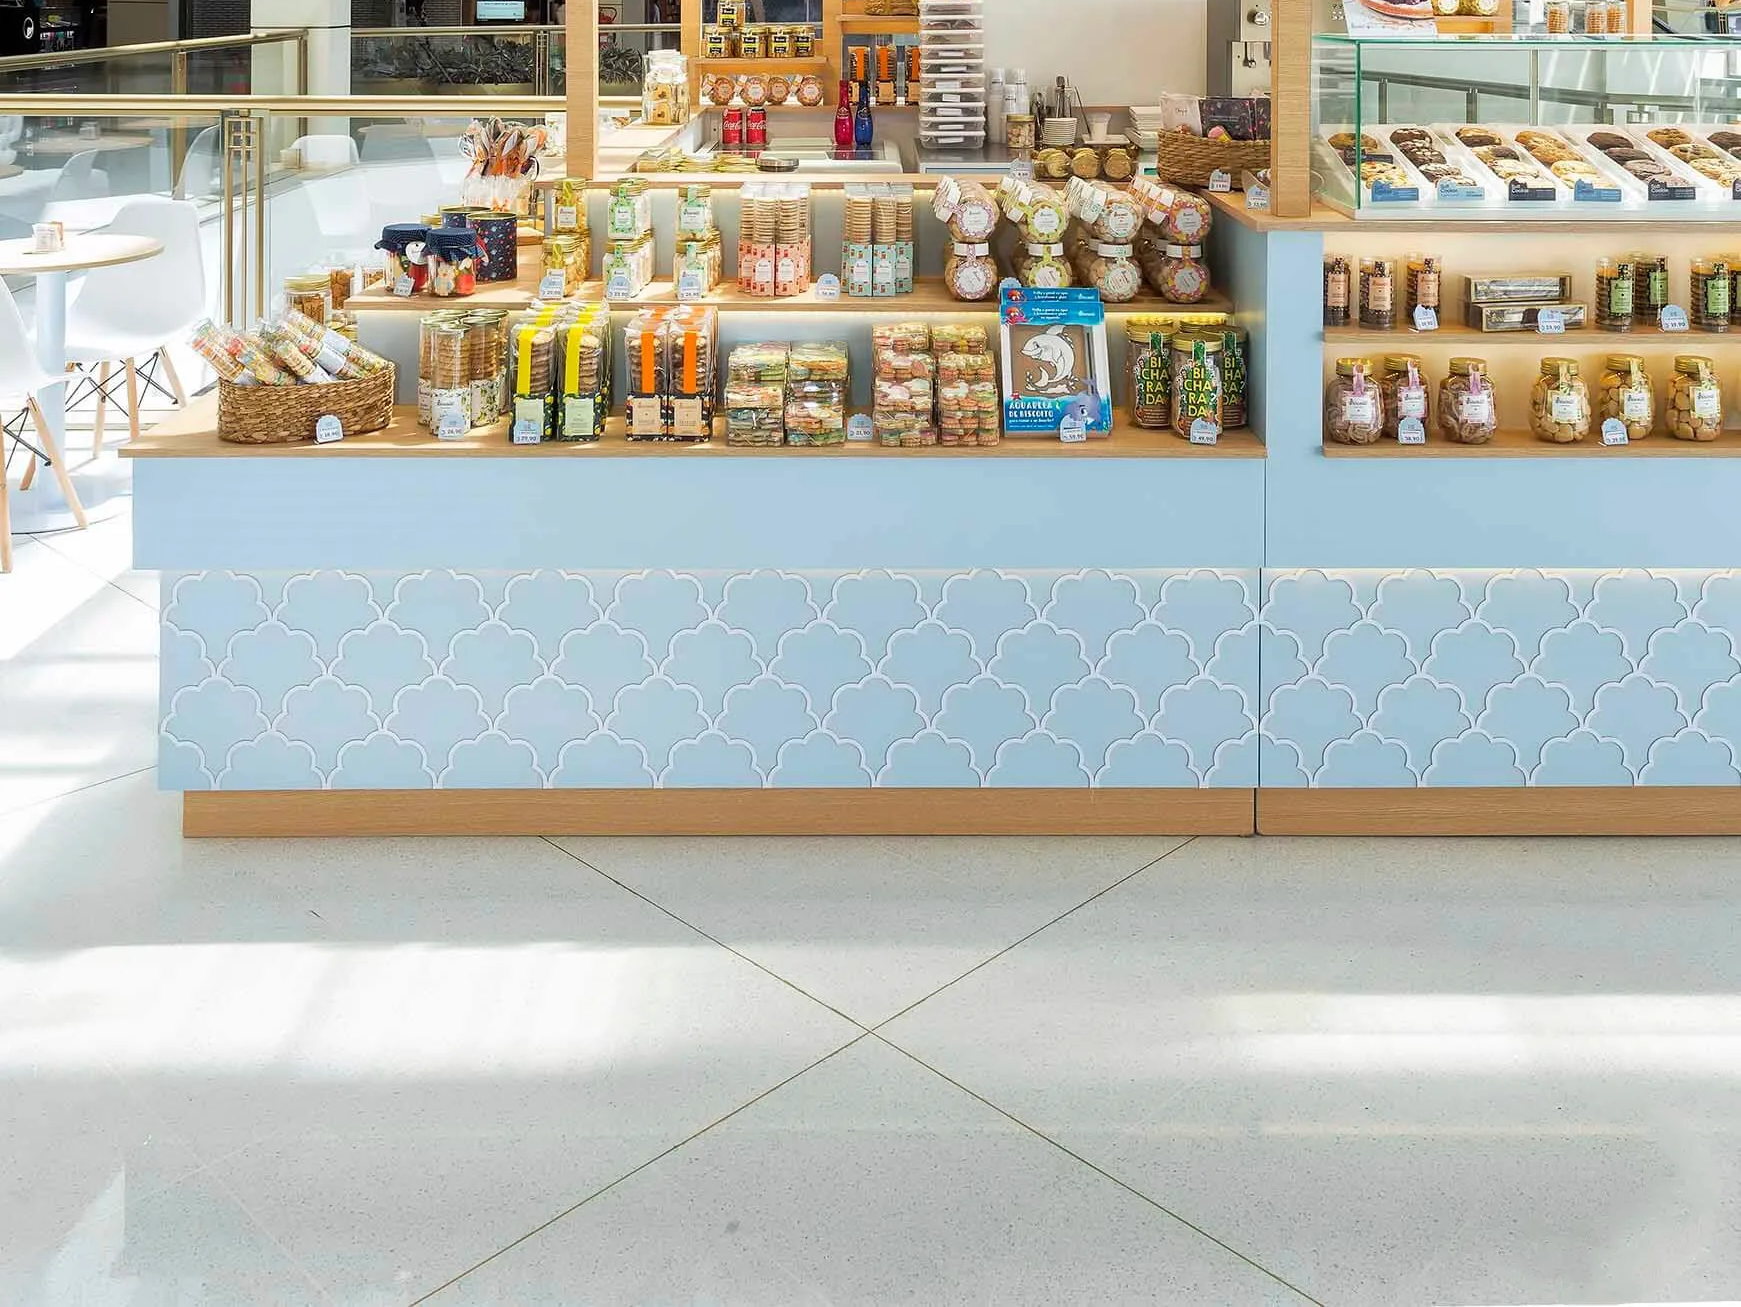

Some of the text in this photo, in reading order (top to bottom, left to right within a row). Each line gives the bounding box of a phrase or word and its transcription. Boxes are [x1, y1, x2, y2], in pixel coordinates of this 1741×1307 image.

[1150, 356, 1161, 368] BI
[1225, 357, 1235, 368] BI
[1142, 368, 1169, 380] CHA
[1193, 367, 1205, 379] BI
[1224, 369, 1242, 381] HA
[1146, 381, 1165, 393] RA
[1184, 380, 1212, 391] CHA
[1146, 394, 1165, 405] DA
[1189, 392, 1207, 404] RA
[1188, 405, 1207, 417] DA
